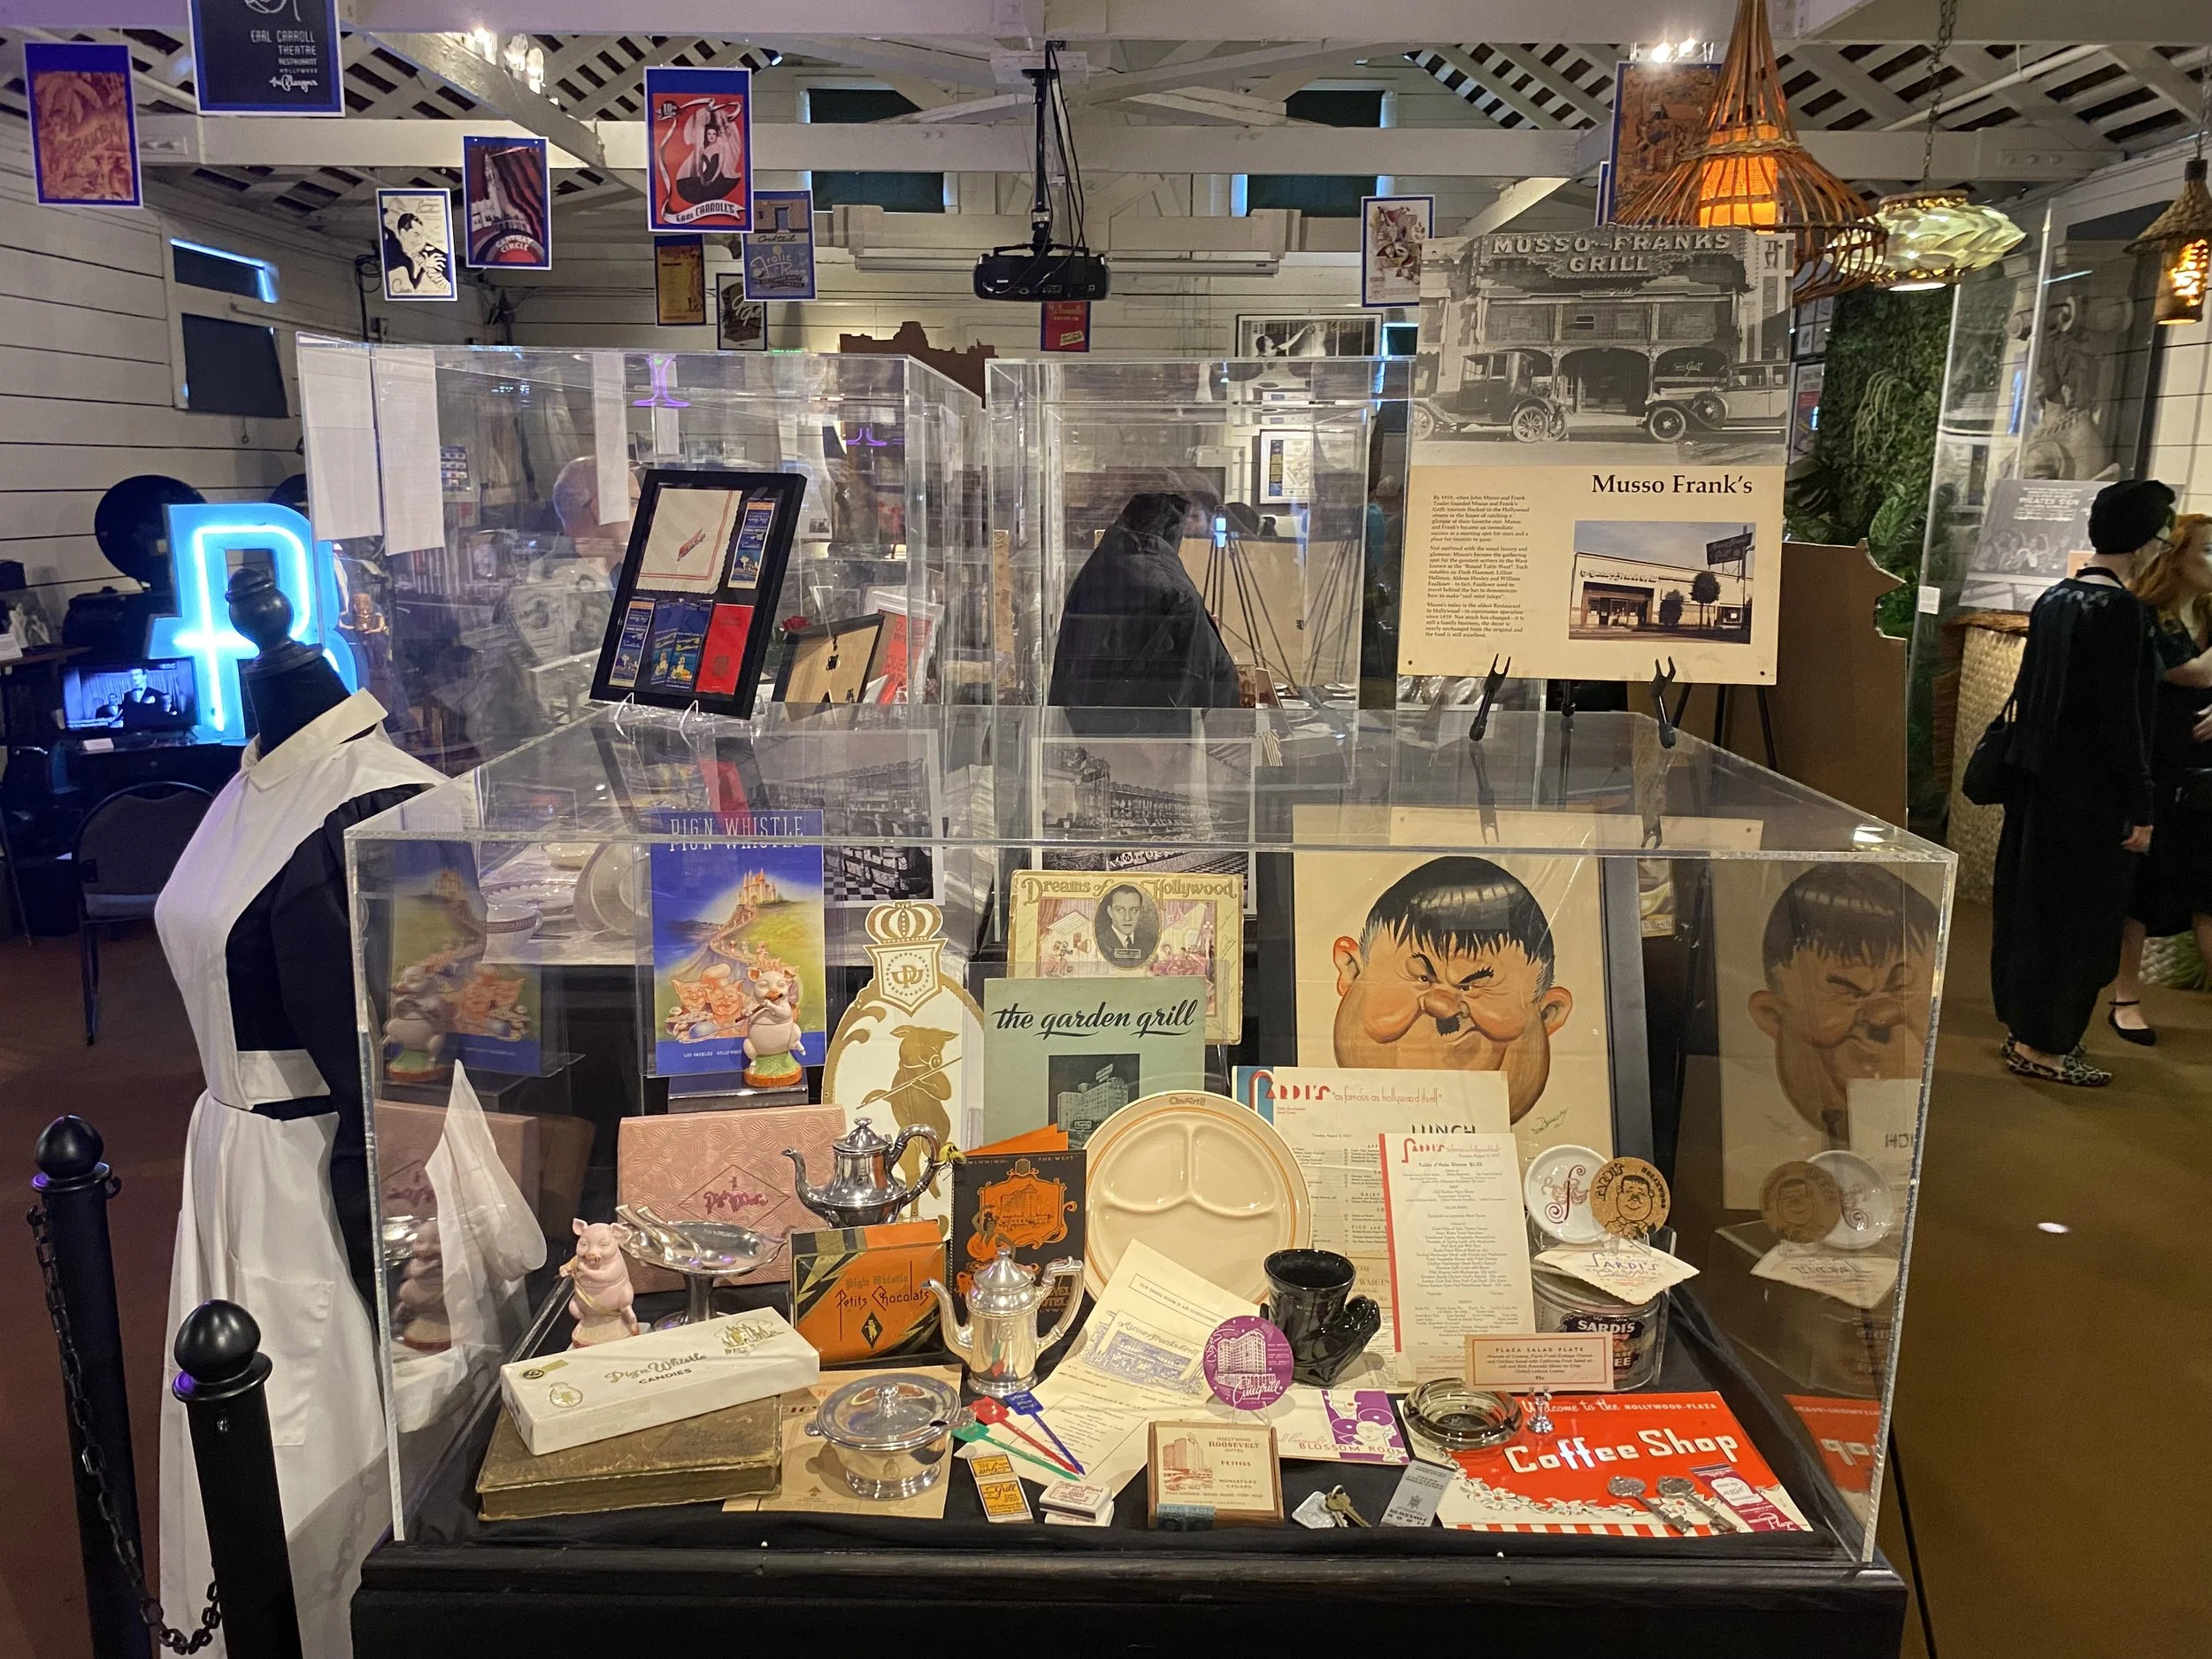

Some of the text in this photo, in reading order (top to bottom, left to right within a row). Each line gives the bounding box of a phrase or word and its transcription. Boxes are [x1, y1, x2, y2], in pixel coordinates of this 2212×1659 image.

[250, 30, 315, 42] EARL CARROLL
[279, 45, 316, 55] THEATRE
[695, 204, 734, 216] CARROLL'S
[758, 234, 796, 243] Cocktail
[500, 243, 529, 253] CIRCLE
[1570, 255, 1648, 273] GRILL
[1592, 474, 1753, 494] Musso Frank's
[724, 817, 803, 849] WHISTLE
[1021, 878, 1238, 911] Dreams of Hollywood
[991, 999, 1198, 1041] the garden grill
[1248, 1069, 1331, 1110] SARDI'S
[1344, 1086, 1370, 1103] famous
[1381, 1087, 1419, 1103] hollywood
[1578, 1319, 1636, 1333] SARDI'S
[648, 1353, 708, 1372] Whistle
[638, 1368, 693, 1385] CANDIES
[1233, 1378, 1281, 1404] Cinegrill
[1520, 1400, 1579, 1414] Wlcome
[1578, 1400, 1596, 1412] to
[1595, 1398, 1620, 1412] the
[1299, 1442, 1406, 1455] BLOSSOM ROOM
[1504, 1428, 1740, 1473] Coffee Shop
[995, 1483, 1017, 1499] Grill
